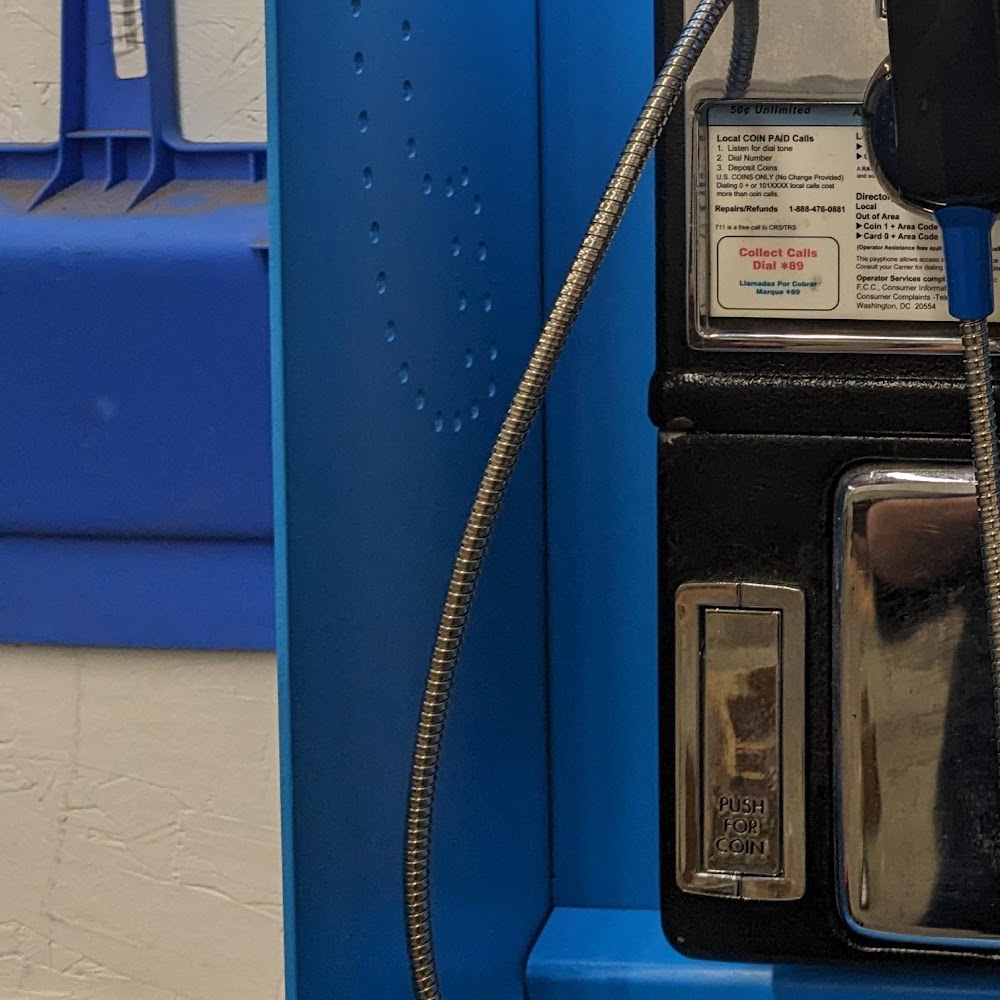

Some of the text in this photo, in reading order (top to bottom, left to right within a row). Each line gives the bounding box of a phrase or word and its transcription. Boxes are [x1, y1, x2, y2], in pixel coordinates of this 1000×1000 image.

[755, 104, 812, 114] Unlimited
[743, 134, 766, 142] COIN
[768, 134, 790, 142] PAID
[792, 134, 814, 142] Calls
[728, 164, 755, 172] Deposit
[715, 206, 778, 214] Repairs/Refunds
[739, 248, 818, 258] Collect Calls
[753, 260, 776, 270] Dial
[720, 797, 764, 814] PUSH
[724, 819, 757, 834] FOR
[716, 838, 764, 854] COIN
